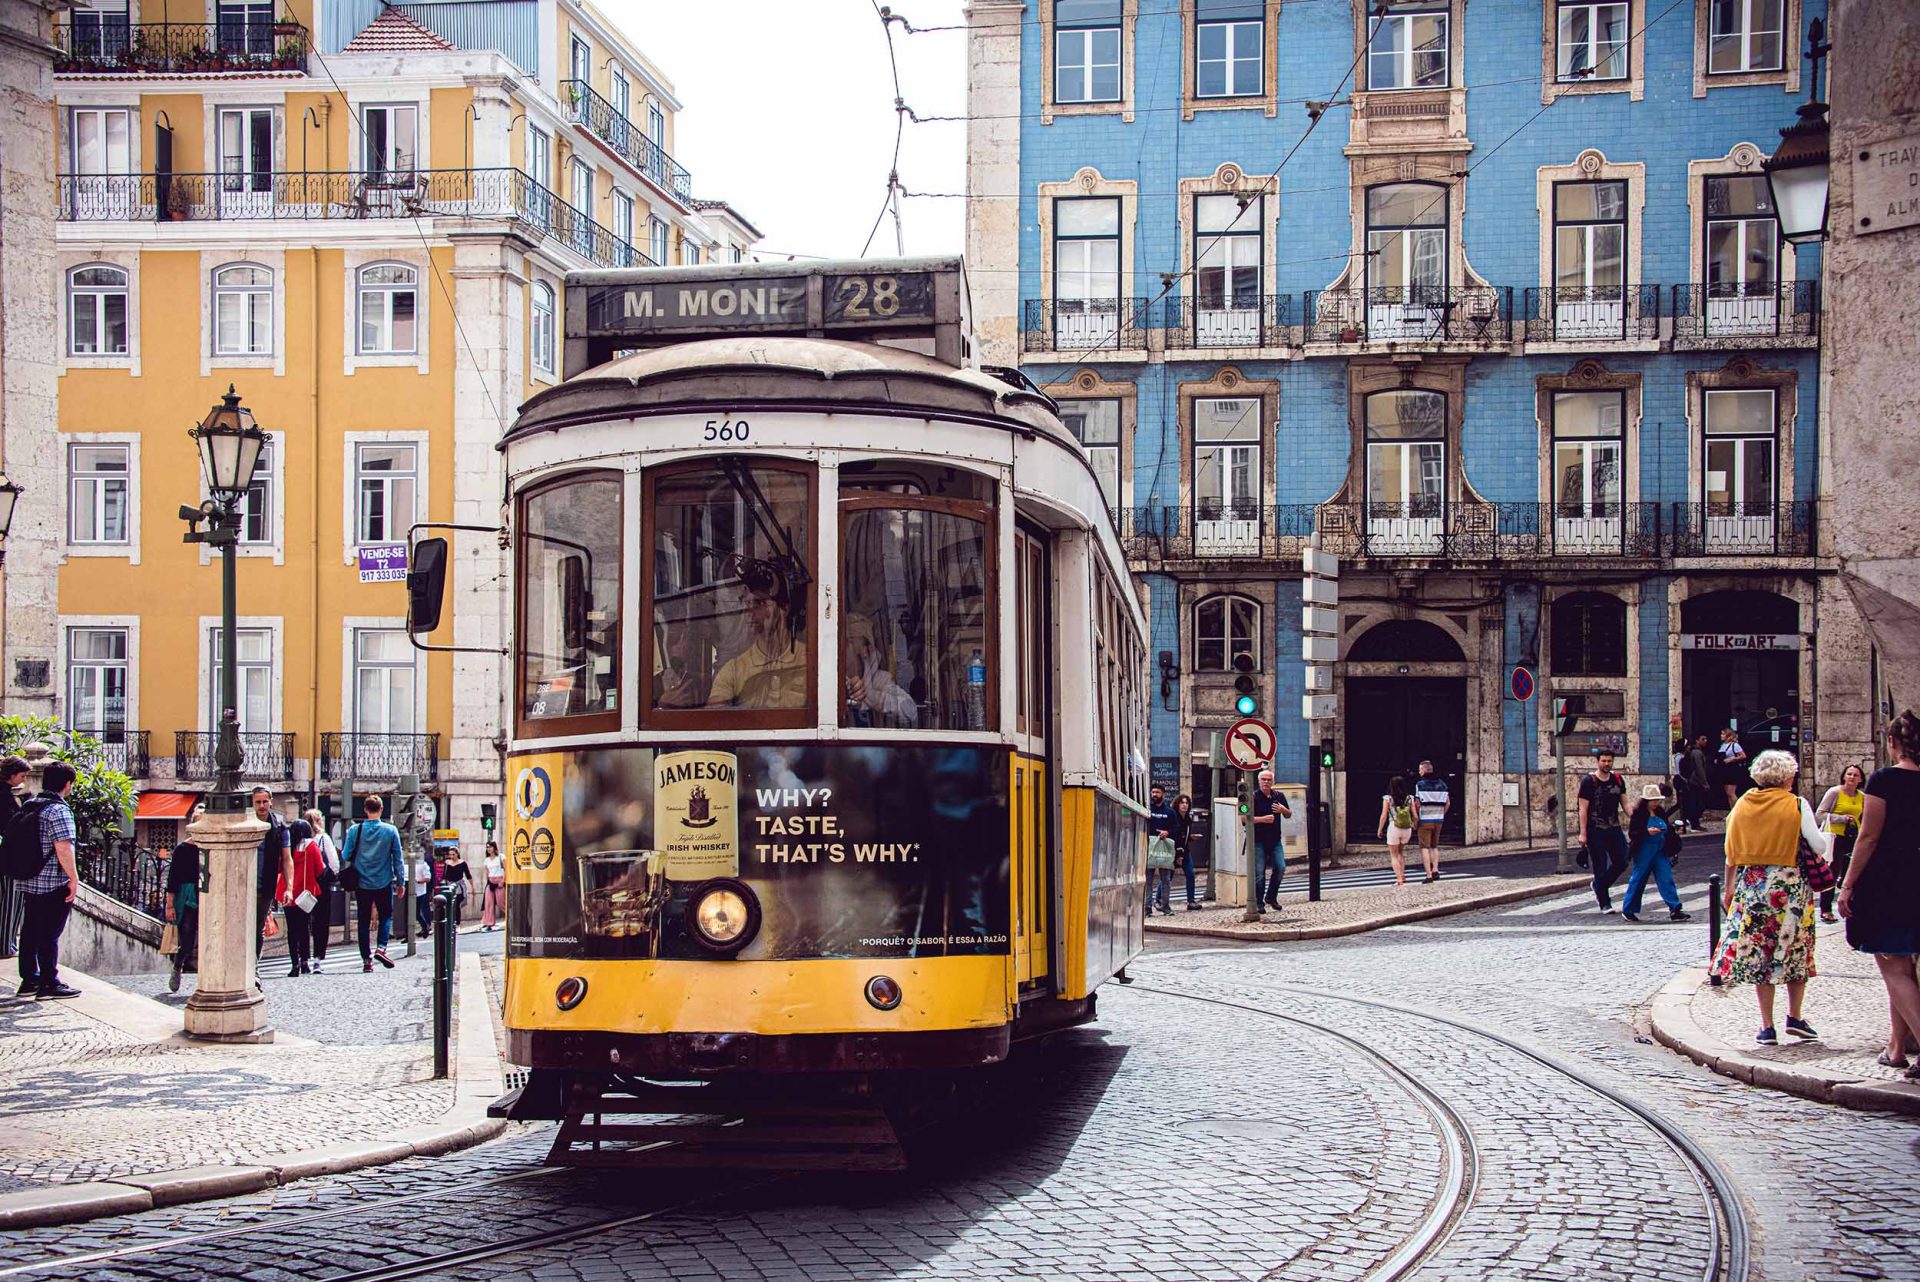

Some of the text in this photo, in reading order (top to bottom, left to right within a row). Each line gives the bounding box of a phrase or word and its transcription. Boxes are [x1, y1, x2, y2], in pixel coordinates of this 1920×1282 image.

[624, 291, 664, 317] M.
[843, 276, 900, 318] 28
[704, 420, 750, 441] 560
[361, 548, 404, 559] VENDE-SE
[377, 559, 388, 569] T2
[361, 570, 405, 581] 917 333 035
[1694, 635, 1734, 649] FOLK
[1747, 635, 1777, 649] ART
[532, 701, 546, 715] 08
[660, 762, 735, 788] JAMESON
[756, 788, 832, 807] WHY?
[756, 816, 845, 838] TASTE,
[667, 843, 730, 852] IRISH WHISKEY
[756, 844, 845, 863] THAT'S
[949, 935, 954, 944] É
[956, 936, 975, 944] ESSA
[984, 934, 1007, 943] RAZÃO
